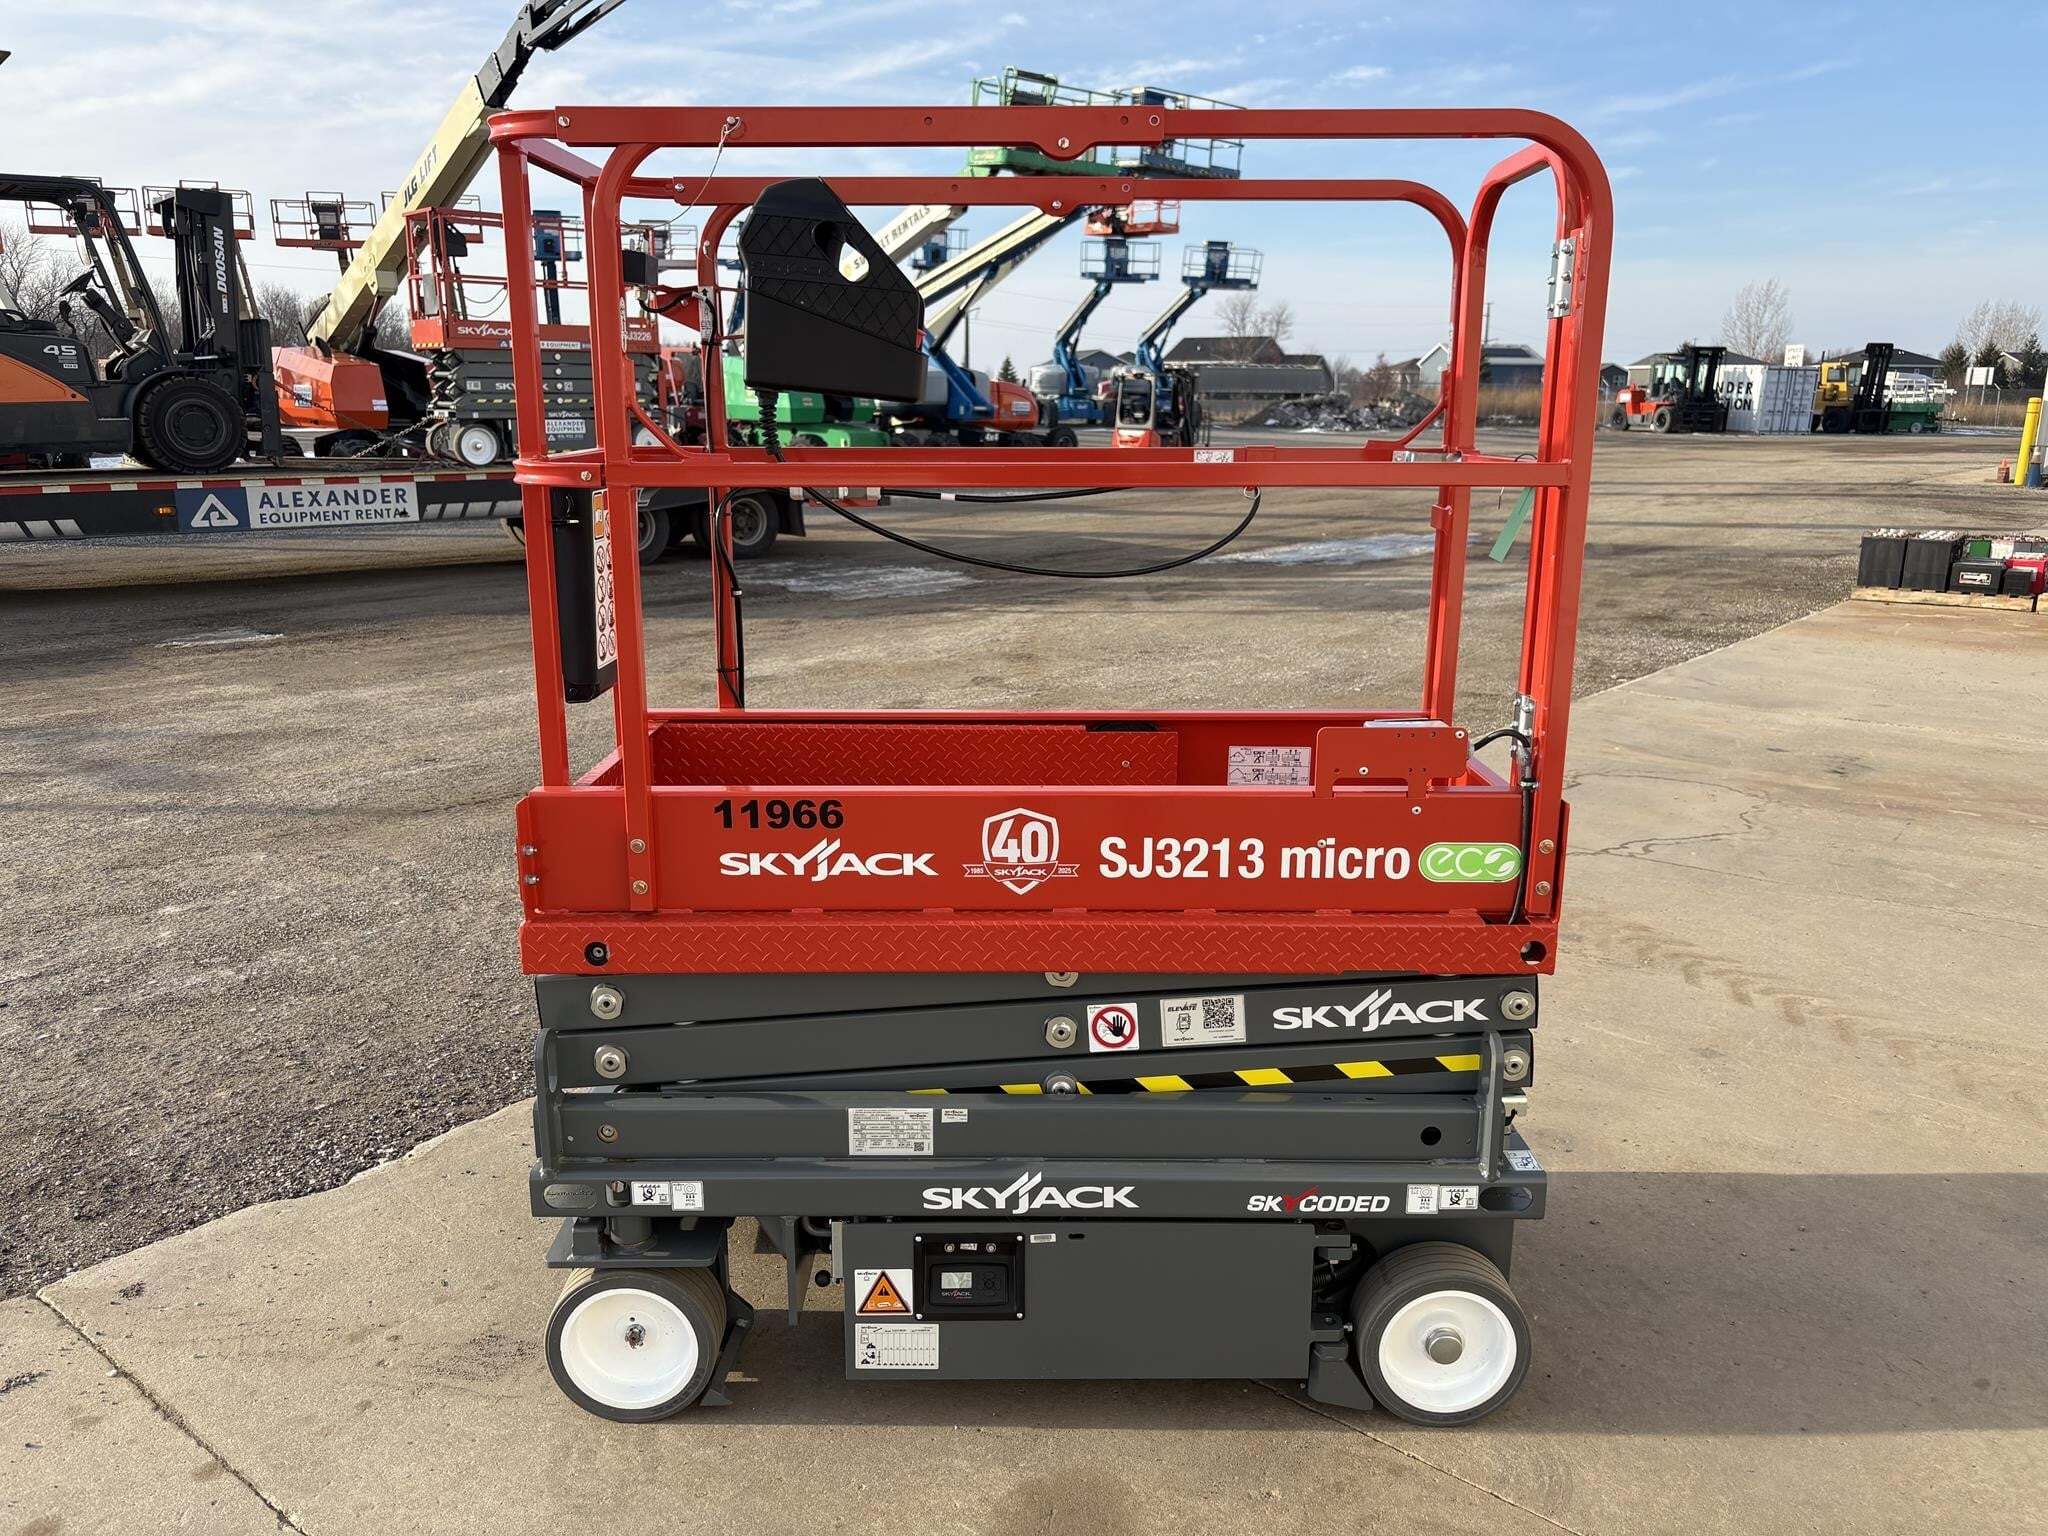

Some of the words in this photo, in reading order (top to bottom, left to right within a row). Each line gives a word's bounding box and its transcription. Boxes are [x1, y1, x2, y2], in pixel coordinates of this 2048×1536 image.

[403, 175, 418, 208] JLG
[420, 144, 437, 184] LIFT
[213, 226, 228, 294] DOOSAN
[43, 345, 77, 356] 45
[259, 488, 408, 509] ALEXANDER
[259, 509, 350, 524] EQUIPMENT
[713, 799, 844, 829] 11966
[991, 818, 1048, 862] 40
[719, 837, 939, 882] SKYJACK
[994, 865, 1047, 876] SKYJACK
[1099, 836, 1265, 879] SJ3213
[1280, 837, 1411, 880] micro
[1426, 847, 1516, 877] eco
[1168, 1001, 1197, 1012] ELEVATE
[1272, 988, 1489, 1031] SKYJACK
[922, 1171, 1140, 1214] SKYJACK
[1247, 1186, 1391, 1213] SKYCODED
